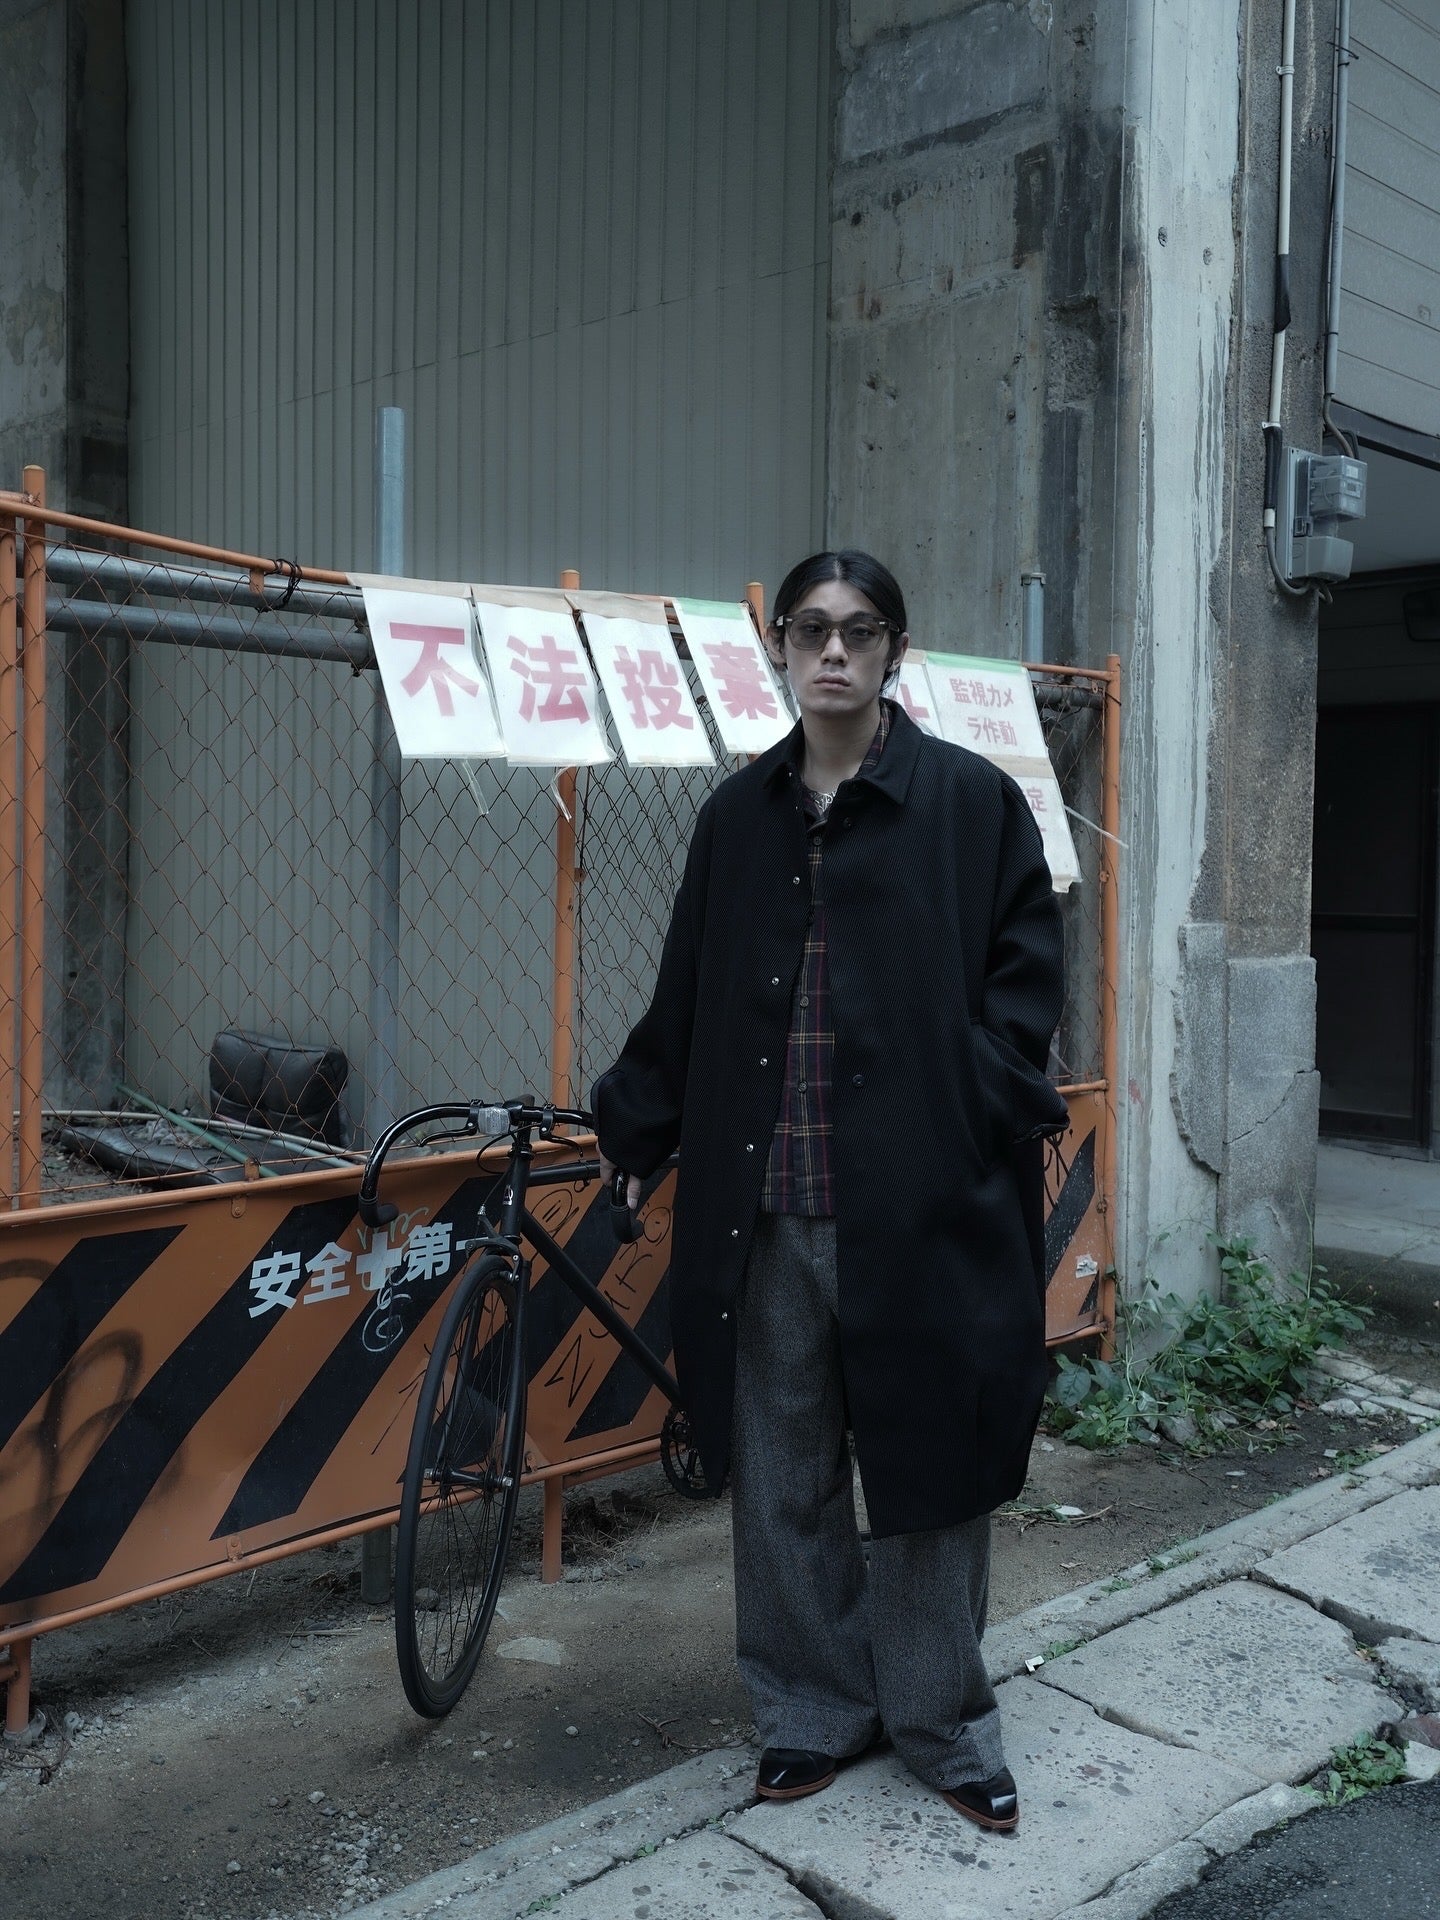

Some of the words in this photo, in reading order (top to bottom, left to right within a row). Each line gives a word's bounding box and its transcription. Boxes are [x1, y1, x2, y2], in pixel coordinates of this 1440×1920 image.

[950, 678, 1014, 708] 監視カメ
[967, 716, 1018, 747] ラ作動
